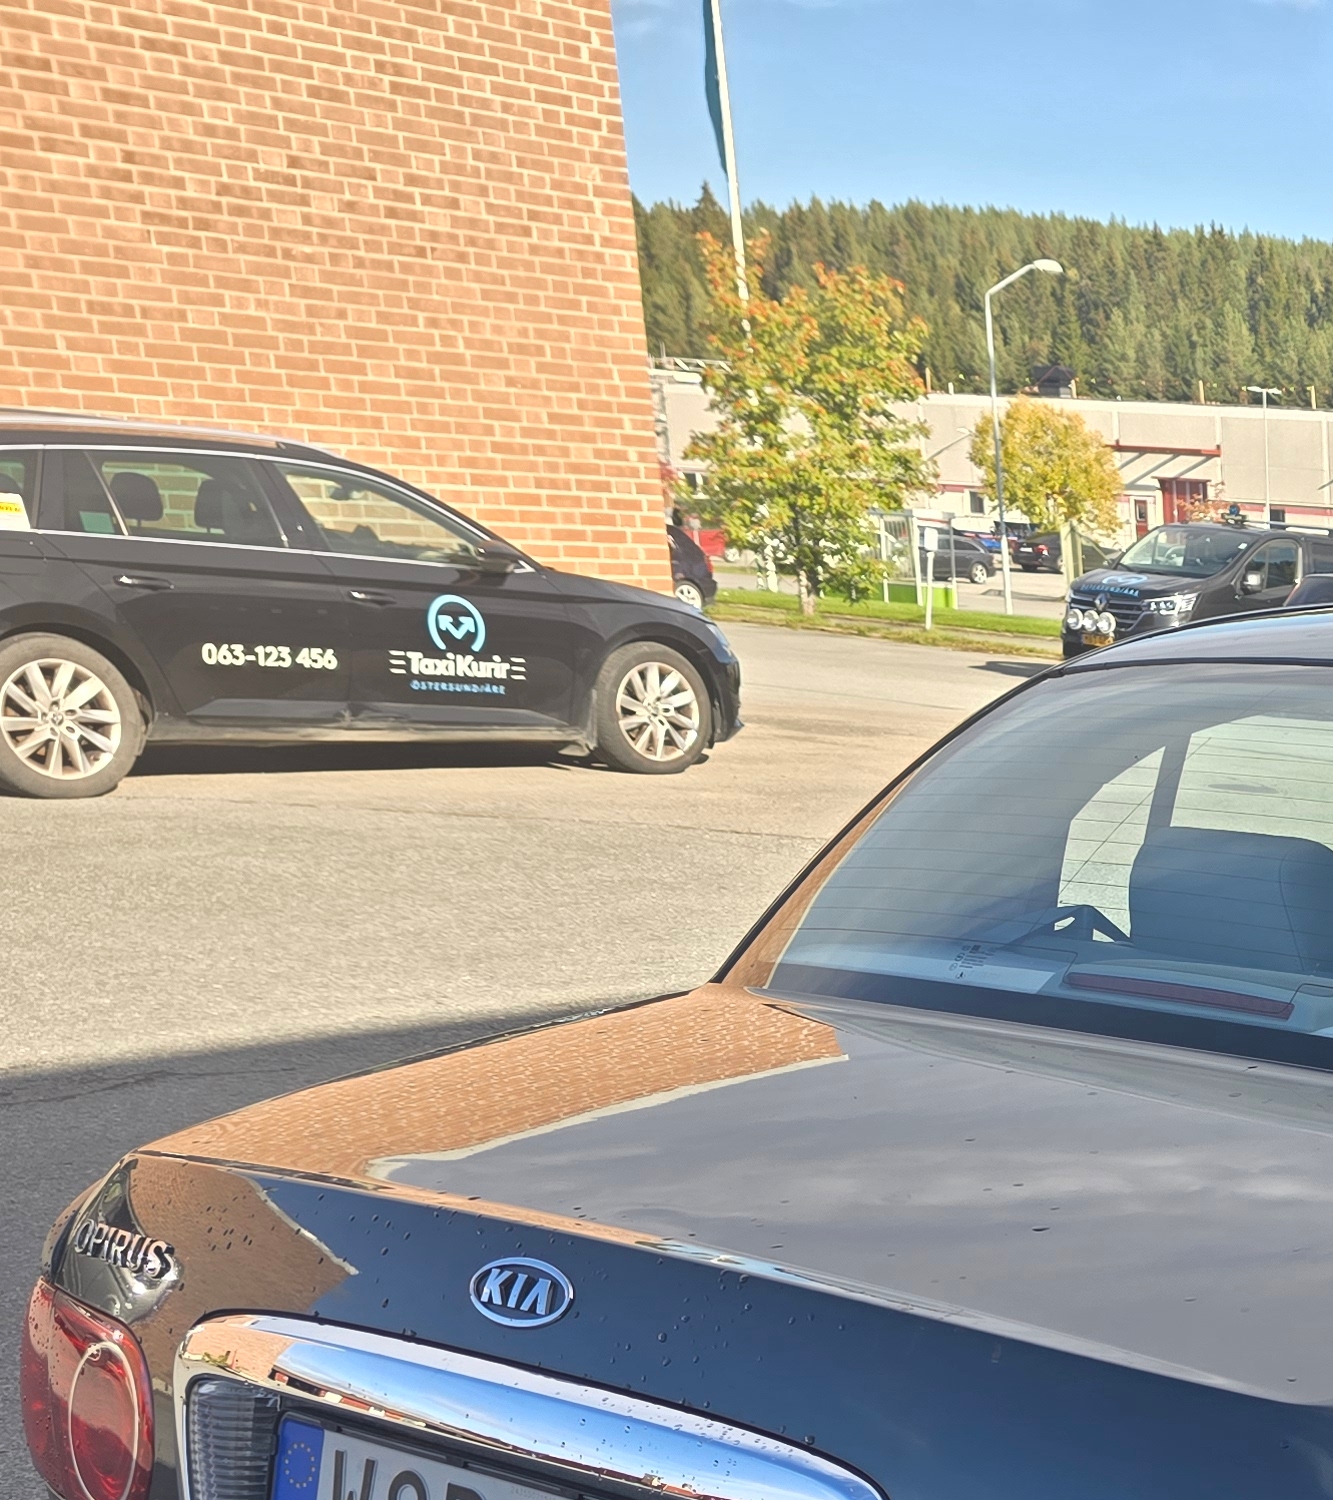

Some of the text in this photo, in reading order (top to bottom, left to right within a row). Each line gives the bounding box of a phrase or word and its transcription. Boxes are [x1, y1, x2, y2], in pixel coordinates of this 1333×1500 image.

[201, 643, 338, 670] 063-123 456
[74, 1219, 175, 1280] OPIRUS
[480, 1267, 552, 1315] KIA
